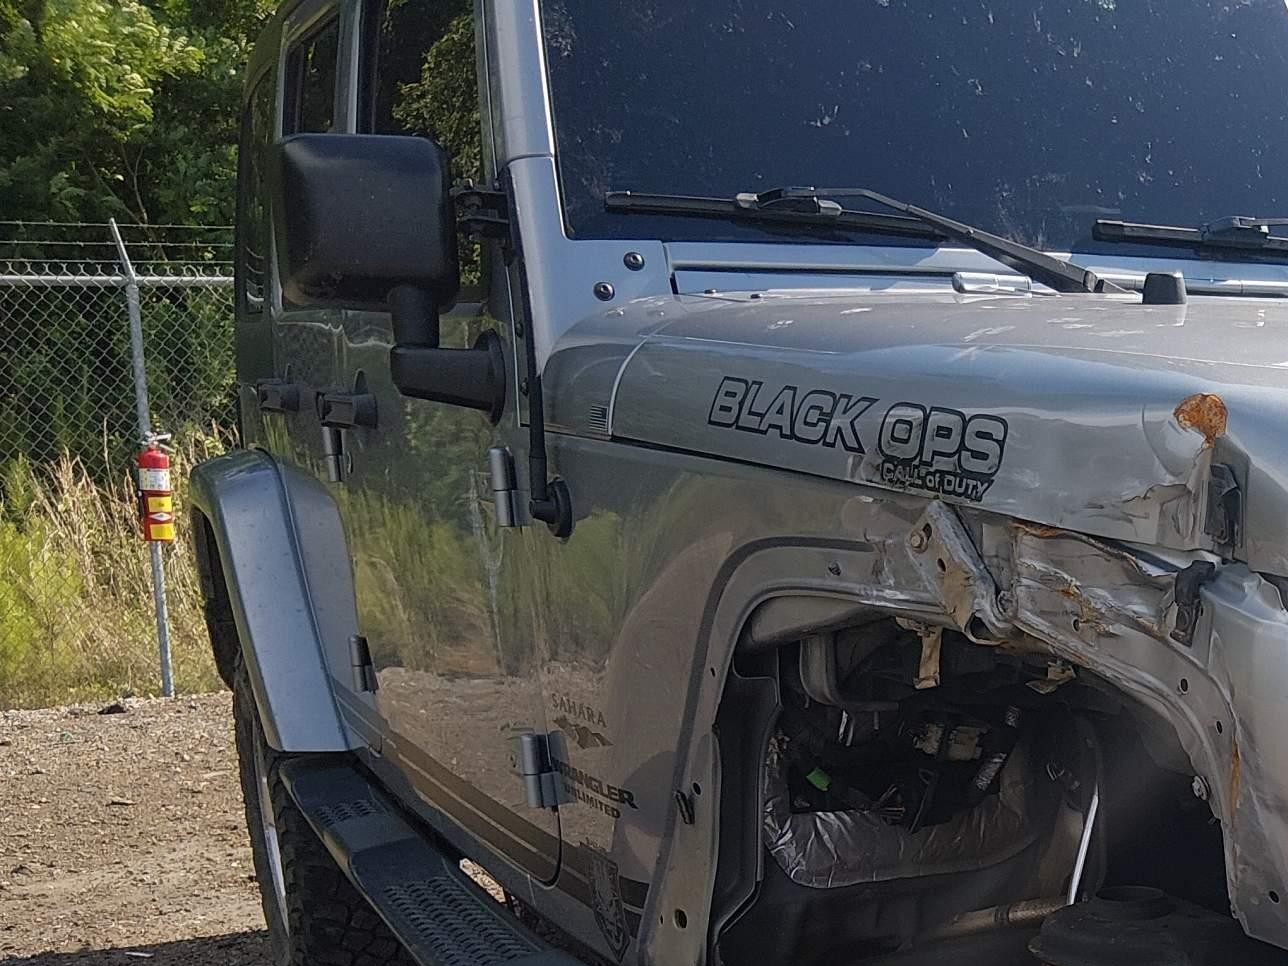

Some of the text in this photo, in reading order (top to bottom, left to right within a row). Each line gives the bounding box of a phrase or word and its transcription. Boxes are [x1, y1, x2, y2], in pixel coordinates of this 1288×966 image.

[708, 376, 1009, 477] BLACK OPS
[881, 459, 993, 501] CALL of DUTY
[552, 692, 608, 729] SAHARA
